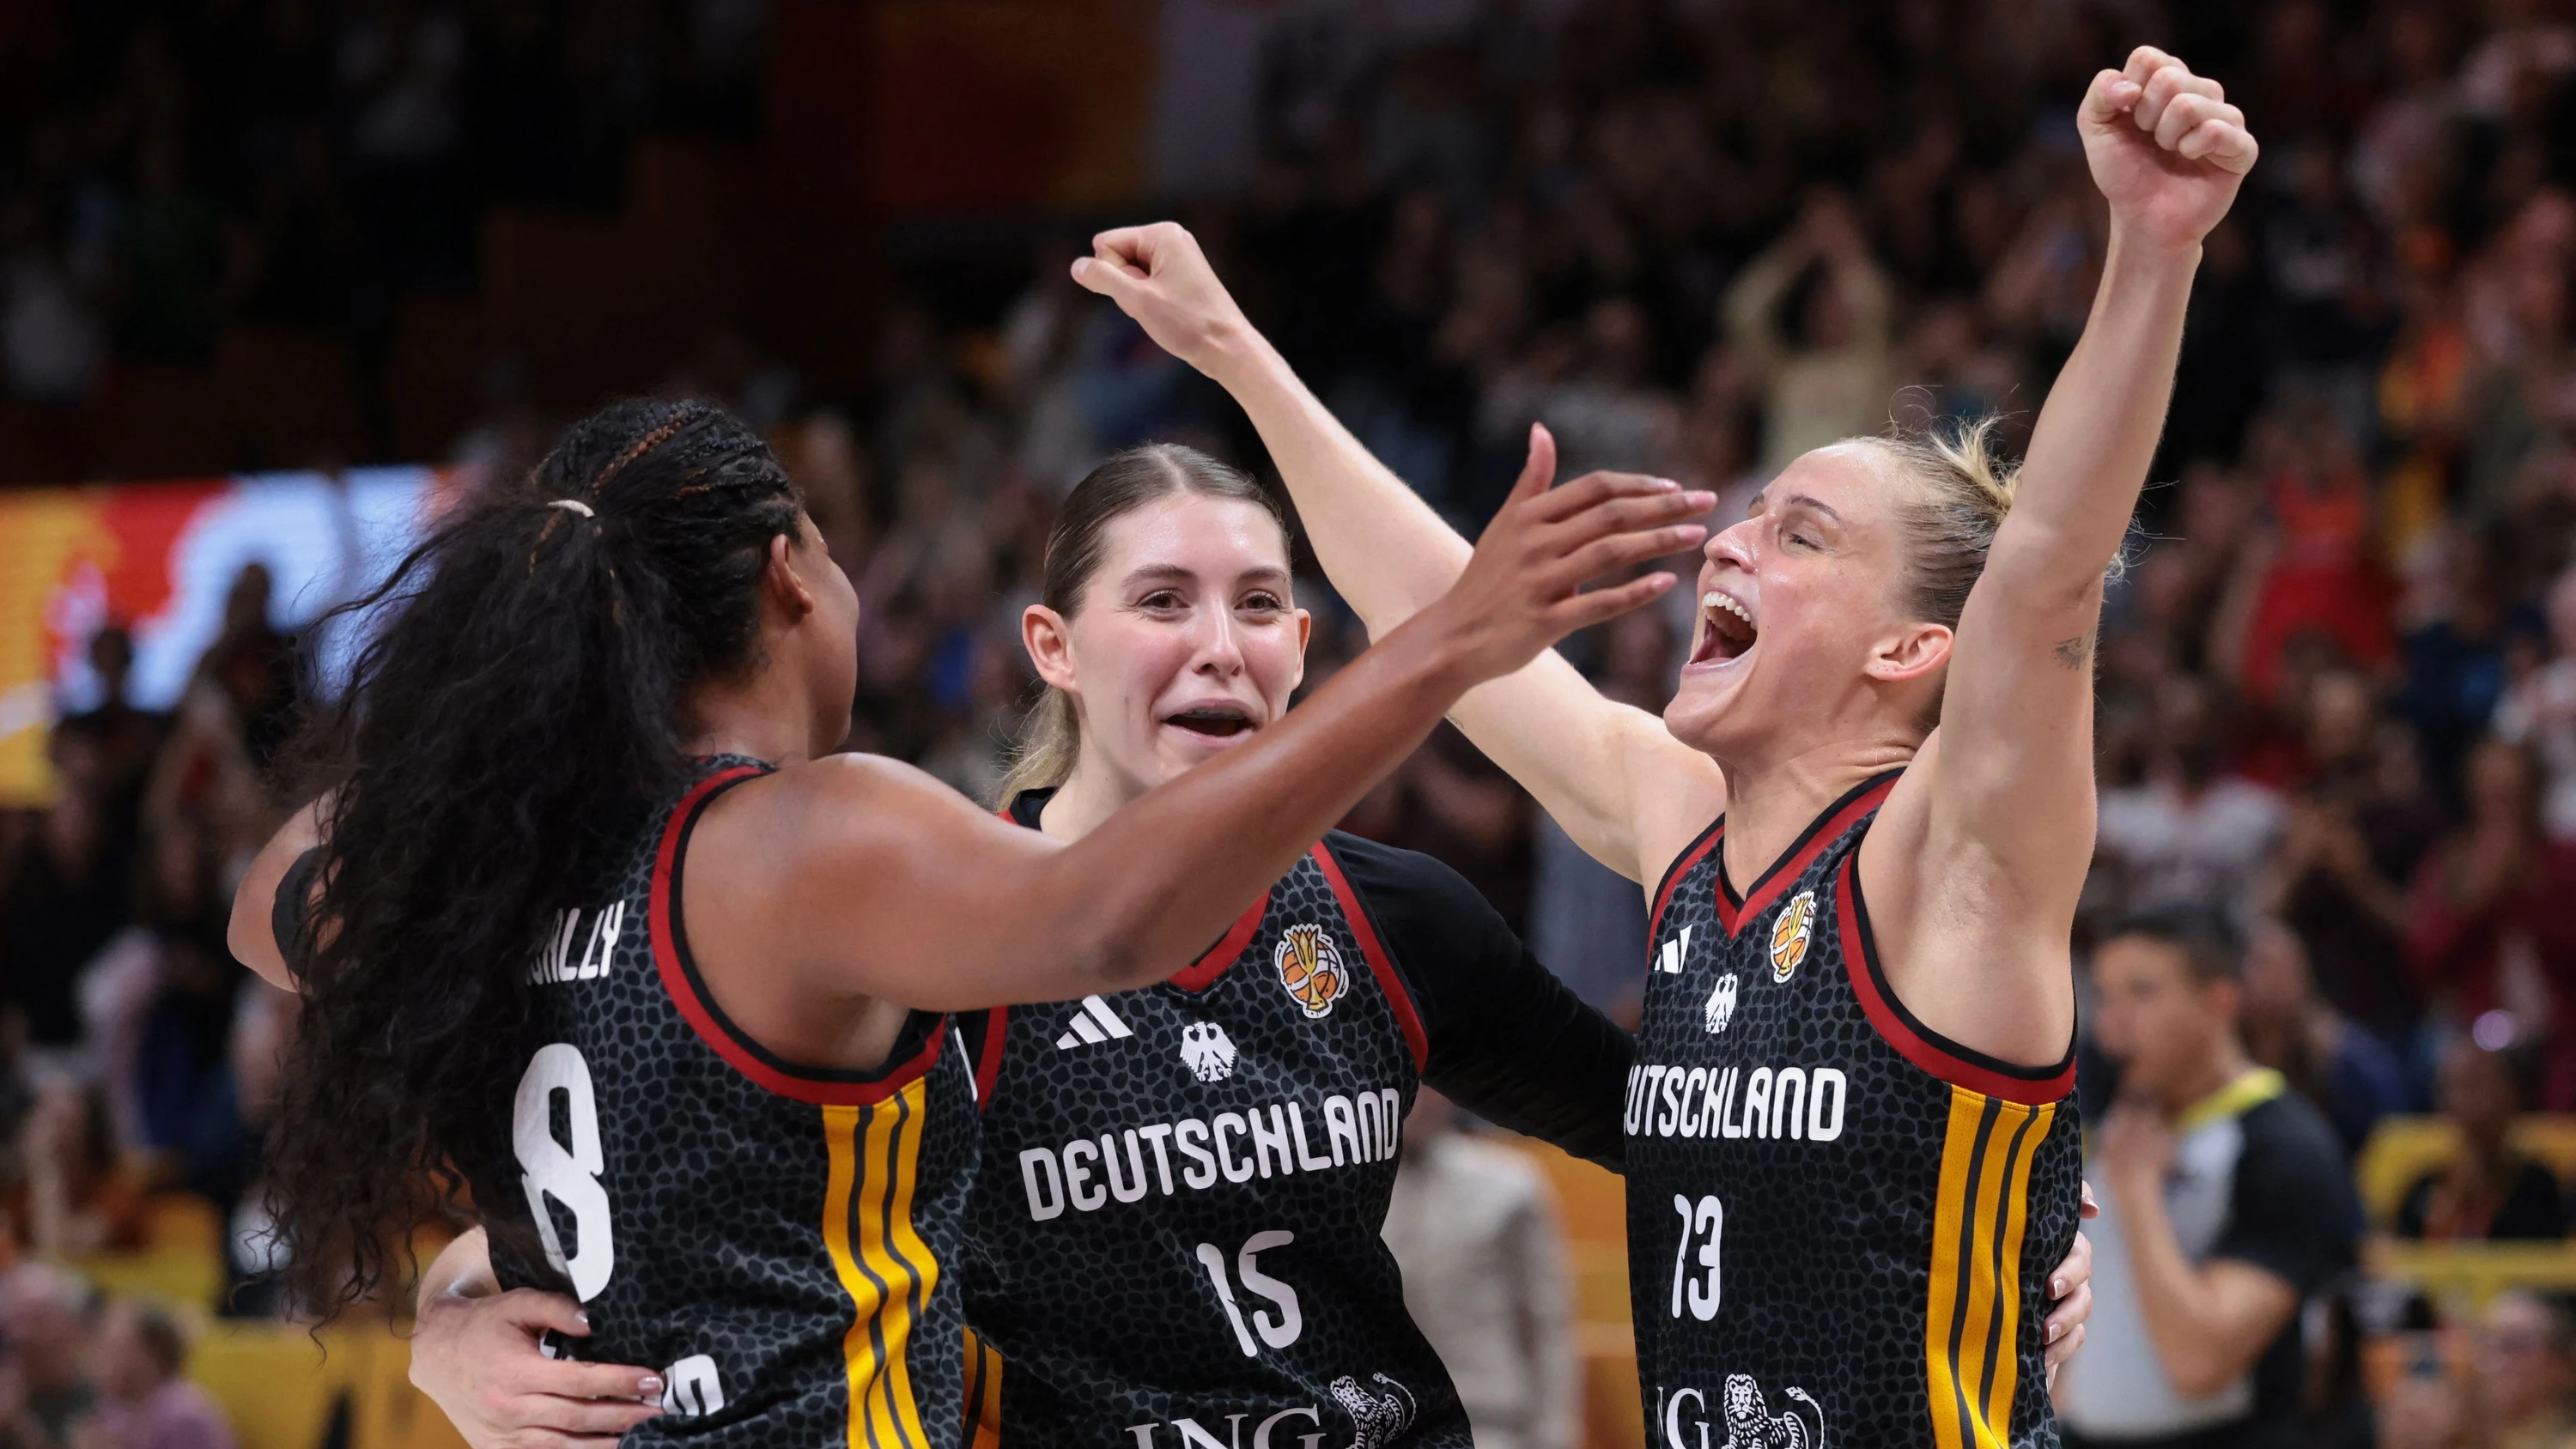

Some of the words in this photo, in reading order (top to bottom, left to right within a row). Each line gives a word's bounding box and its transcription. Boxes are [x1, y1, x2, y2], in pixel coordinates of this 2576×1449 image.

[1019, 1088, 1400, 1222] DEUTSCHLAND
[1623, 1064, 1847, 1142] UTSCHLAND
[513, 1042, 614, 1303] 8
[1196, 1230, 1303, 1357] 15
[1671, 1194, 1723, 1321] 13
